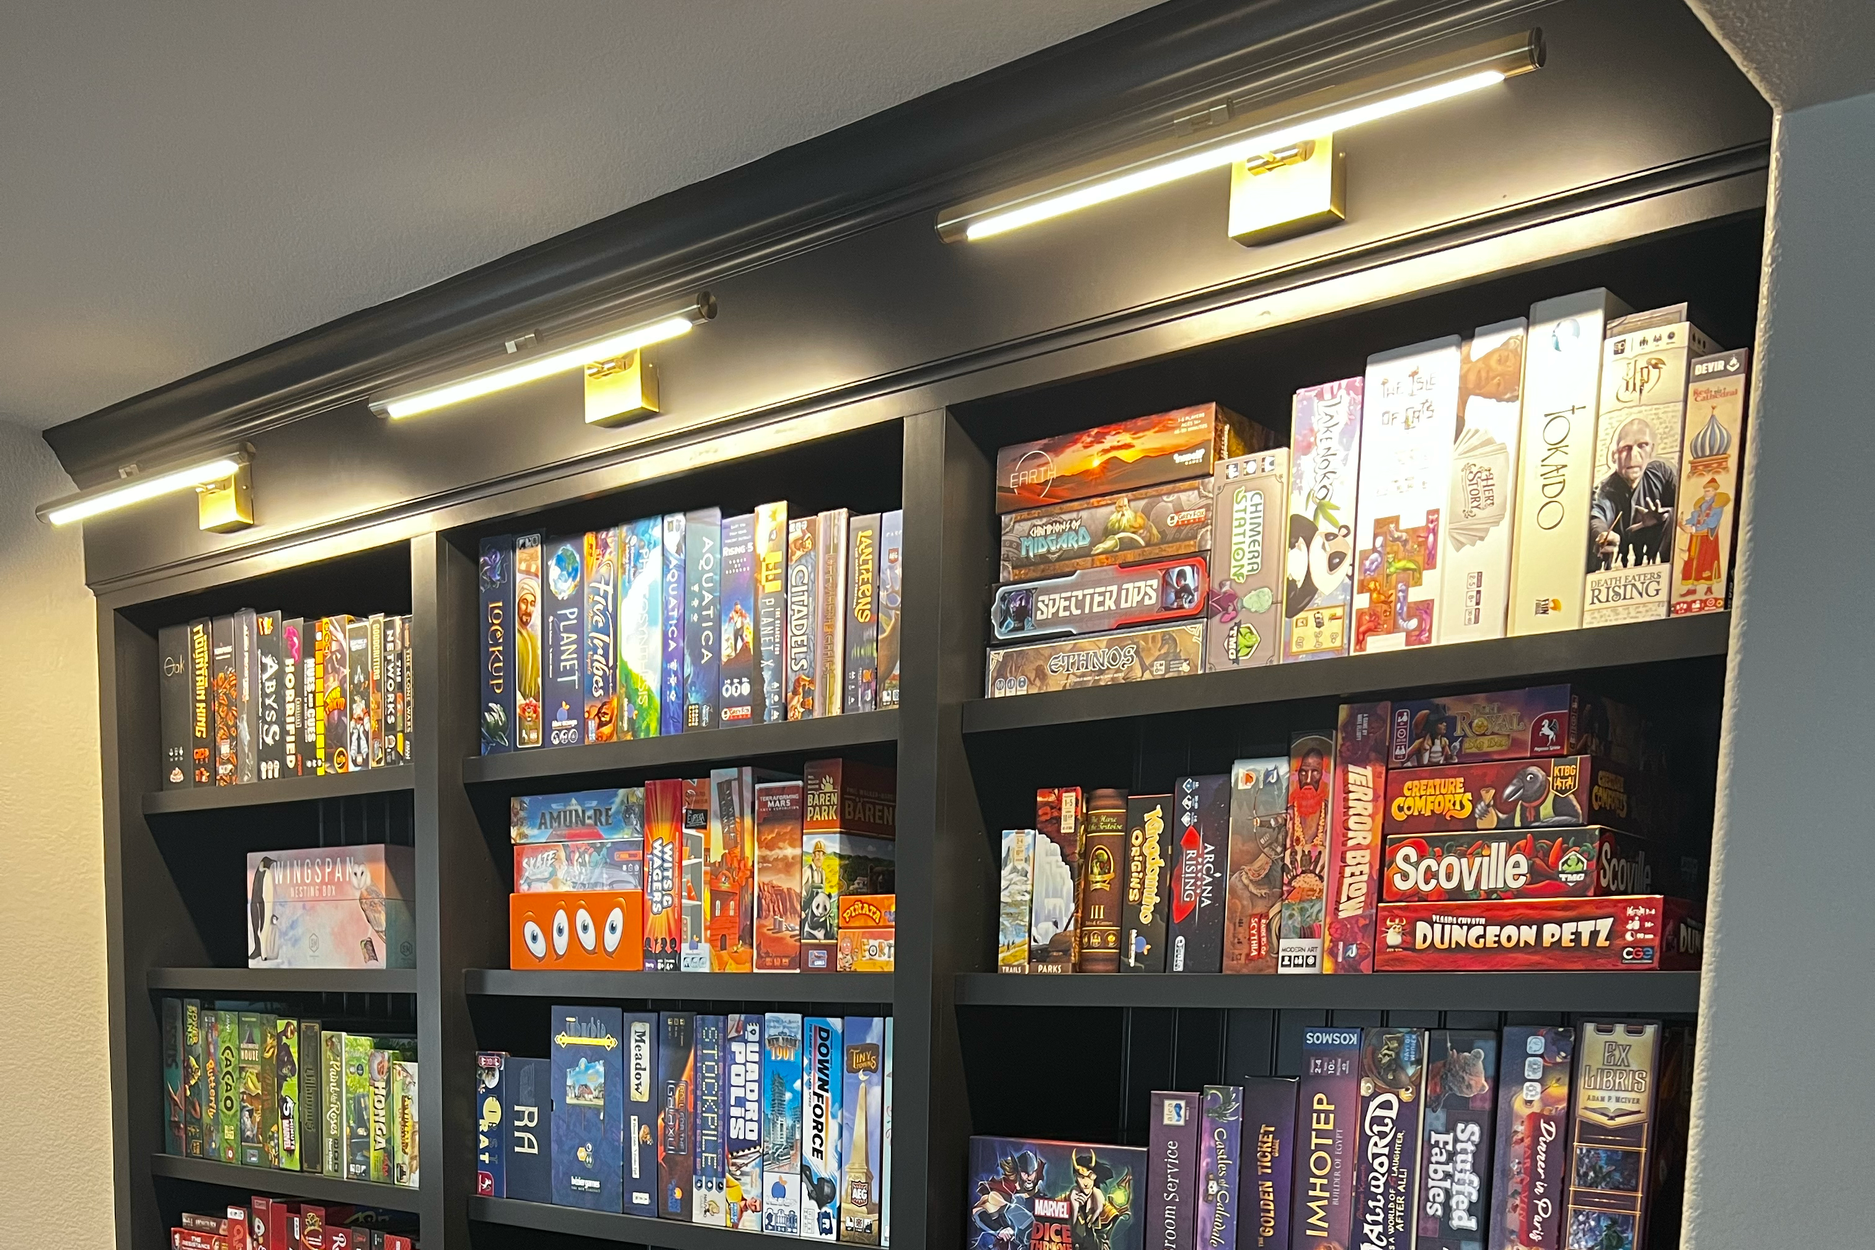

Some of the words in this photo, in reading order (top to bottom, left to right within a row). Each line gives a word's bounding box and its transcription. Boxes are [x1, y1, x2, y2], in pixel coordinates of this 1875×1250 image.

[1407, 367, 1436, 397] ISLE
[1694, 360, 1725, 376] DEVIR
[1382, 411, 1399, 425] OF
[1315, 395, 1344, 501] TAKENOKO
[1536, 404, 1586, 531] TOKAIDO
[1010, 466, 1056, 488] EARTH
[1467, 469, 1482, 511] STORY
[1482, 467, 1496, 507] HER
[1019, 526, 1091, 558] MIDGARD
[1030, 521, 1071, 537] CHAMPIONS
[1072, 518, 1082, 530] OF
[1230, 486, 1248, 584] STATION
[1248, 490, 1264, 575] CHIMERA
[589, 560, 614, 629] Five
[853, 529, 873, 623] LANTERNS
[1589, 580, 1661, 606] RISING
[1590, 576, 1623, 589] DEATH
[1624, 571, 1661, 583] EATERS
[667, 559, 678, 651] AQUATICA
[701, 537, 714, 664] AQUATICA
[790, 565, 809, 672] CITADELS
[1036, 584, 1117, 622] SPECTER
[1122, 579, 1158, 608] OPS
[761, 597, 775, 652] PLANET
[193, 624, 208, 700] MOUNTAIN
[487, 601, 503, 694] LOCKUP
[557, 607, 579, 689] PLANET
[589, 611, 614, 698] Tribes
[760, 659, 774, 668] X
[1047, 645, 1137, 676] ETHNOS
[306, 658, 316, 693] HUES
[386, 629, 396, 725] NETWORKS
[195, 702, 207, 738] KING
[261, 654, 280, 747] ABYSS
[285, 658, 297, 769] HORRIFIED
[306, 708, 316, 743] CUES
[1454, 711, 1526, 738] ROYAL
[1403, 777, 1465, 796] CREATURE
[1554, 765, 1577, 777] KTBG
[760, 794, 800, 802] TERRAFORMING
[767, 800, 792, 808] MARS
[807, 791, 838, 806] BÄREN
[807, 806, 837, 821] PARK
[1345, 764, 1373, 848] TERROR
[1391, 790, 1473, 822] COMFORTS
[537, 808, 614, 831] AMUN-RE
[274, 857, 355, 885] WINGSPAN
[522, 850, 558, 872] SKATE
[651, 837, 662, 914] WAGERS
[662, 842, 674, 890] WITS
[1138, 803, 1166, 925] Kingdomino
[1183, 850, 1198, 902] RISING
[1201, 843, 1223, 907] ARCANA
[1393, 842, 1529, 892] Scoville
[1558, 873, 1586, 883] TMG
[290, 885, 320, 898] NESTING
[322, 884, 337, 897] BOX
[1338, 850, 1372, 918] BELOW
[842, 900, 881, 925] PIÑATA
[1250, 917, 1259, 957] SCYTHIA
[1415, 920, 1538, 951] DUNGEON
[1542, 917, 1615, 949] PETZ
[1622, 946, 1654, 960] CGE
[1002, 965, 1022, 974] TRAILS
[1038, 964, 1062, 974] PARKS
[771, 1046, 796, 1061] 1901
[1306, 1032, 1357, 1045] KOSMOS
[1602, 1040, 1632, 1067] EX
[220, 1045, 235, 1112] CACAO
[633, 1029, 647, 1096] Meadow
[849, 1049, 872, 1069] TINY
[1583, 1065, 1648, 1093] LIBRIS
[205, 1059, 217, 1120] Butterfly
[702, 1026, 717, 1169] STOCKPILE
[745, 1022, 760, 1141] QUADRO
[811, 1027, 831, 1162] DOWNFORCE
[1615, 1096, 1640, 1104] MCIVER
[374, 1081, 387, 1151] HONGA
[514, 1104, 539, 1155] RA
[479, 1118, 490, 1165] RAT
[1214, 1127, 1233, 1176] Castles
[1257, 1124, 1276, 1175] TICKET
[1335, 1128, 1345, 1157] EGYPT
[1364, 1091, 1399, 1200] WORLD
[1534, 1117, 1557, 1180] Dinner
[1163, 1140, 1180, 1202] Service
[1305, 1092, 1335, 1238] IMHOTEP
[1334, 1158, 1342, 1170] OF
[1426, 1131, 1453, 1218] Fables
[1449, 1121, 1481, 1231] Stuffed
[852, 1188, 868, 1199] AEG
[1332, 1172, 1342, 1206] BUILDER
[1389, 1188, 1396, 1200] OF
[1534, 1180, 1548, 1195] in
[1034, 1198, 1070, 1219] MARVEL
[1209, 1190, 1231, 1247] Caladale
[1259, 1181, 1275, 1237] GOLDEN
[1388, 1200, 1396, 1235] WORLD
[1395, 1195, 1405, 1232] AFTER
[1528, 1198, 1552, 1242] Paris
[1032, 1220, 1073, 1244] DICE
